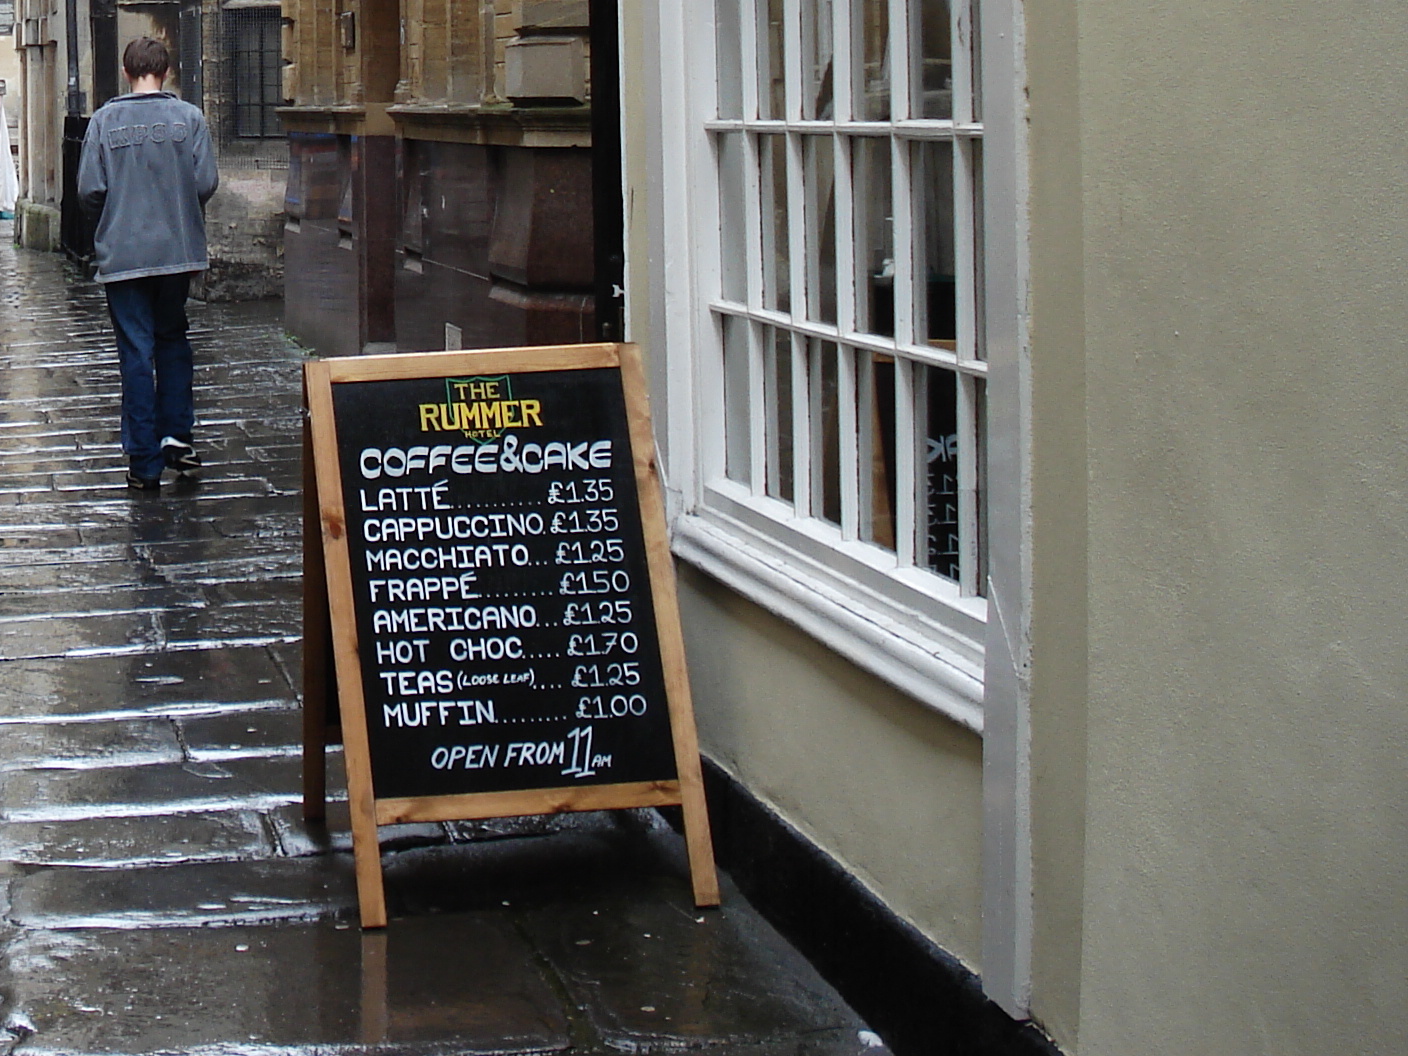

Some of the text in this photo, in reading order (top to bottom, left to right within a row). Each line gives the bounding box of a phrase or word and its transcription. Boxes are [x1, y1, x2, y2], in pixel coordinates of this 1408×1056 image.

[453, 381, 501, 401] THE
[418, 399, 544, 432] RUMMER
[464, 429, 502, 439] HOTEL
[360, 478, 614, 512] LATTÉ £1.35
[363, 509, 619, 542] CAPPUCCINO £1.35
[365, 544, 529, 572] MACCHIATO
[369, 571, 478, 602] FRAPPÉ
[373, 607, 536, 634] AMERICANO
[377, 632, 638, 664] HOT CHOC £1.70
[380, 670, 454, 696] TEAS
[571, 662, 641, 687] £1.25
[383, 694, 647, 728] MUFFIN £1.00
[430, 746, 498, 771] OPEN
[503, 743, 565, 769] FROM
